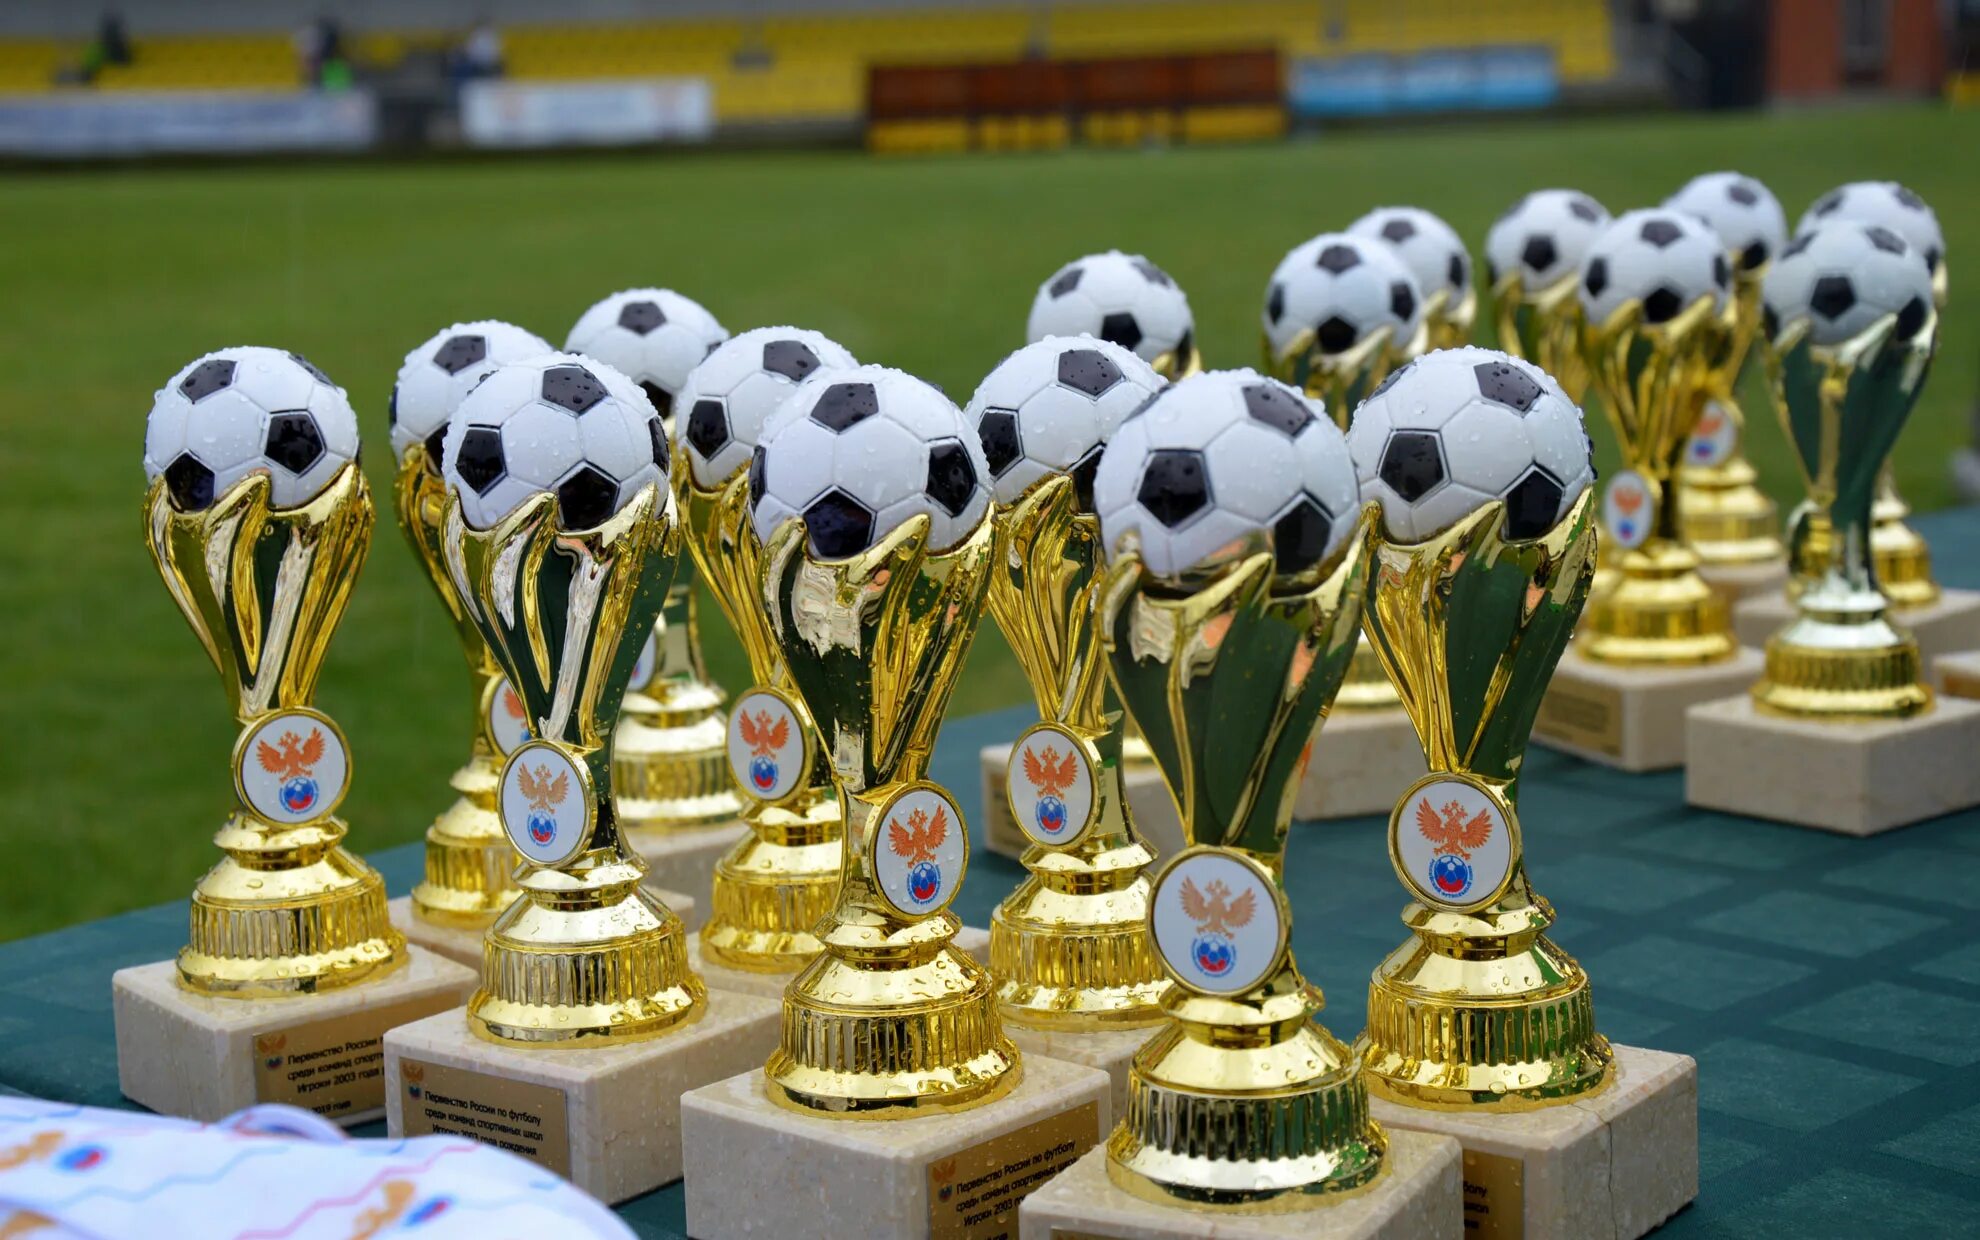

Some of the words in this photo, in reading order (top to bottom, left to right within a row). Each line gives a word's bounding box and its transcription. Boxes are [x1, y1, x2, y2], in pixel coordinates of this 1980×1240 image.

[288, 1046, 343, 1065] Первенство
[345, 1038, 377, 1051] России
[288, 1067, 315, 1081] среди
[317, 1058, 352, 1073] команд
[297, 1079, 332, 1094] Игроки
[333, 1072, 357, 1086] 2003
[358, 1066, 379, 1080] года
[425, 1090, 468, 1109] Первенство
[469, 1100, 496, 1115] России
[497, 1108, 507, 1118] по
[508, 1108, 541, 1127] футболу
[425, 1108, 447, 1119] среди
[448, 1112, 476, 1128] команд
[477, 1119, 521, 1136] спортивных
[522, 1129, 543, 1142] школ
[956, 1169, 1002, 1195] Первенство
[1004, 1157, 1031, 1176] России
[1032, 1153, 1042, 1165] по
[1043, 1140, 1076, 1161] футболу
[956, 1198, 979, 1212] среди
[981, 1183, 1009, 1202] команд
[1011, 1166, 1055, 1190] спортивных
[964, 1209, 992, 1227] Игроки
[993, 1198, 1013, 1216] 2003
